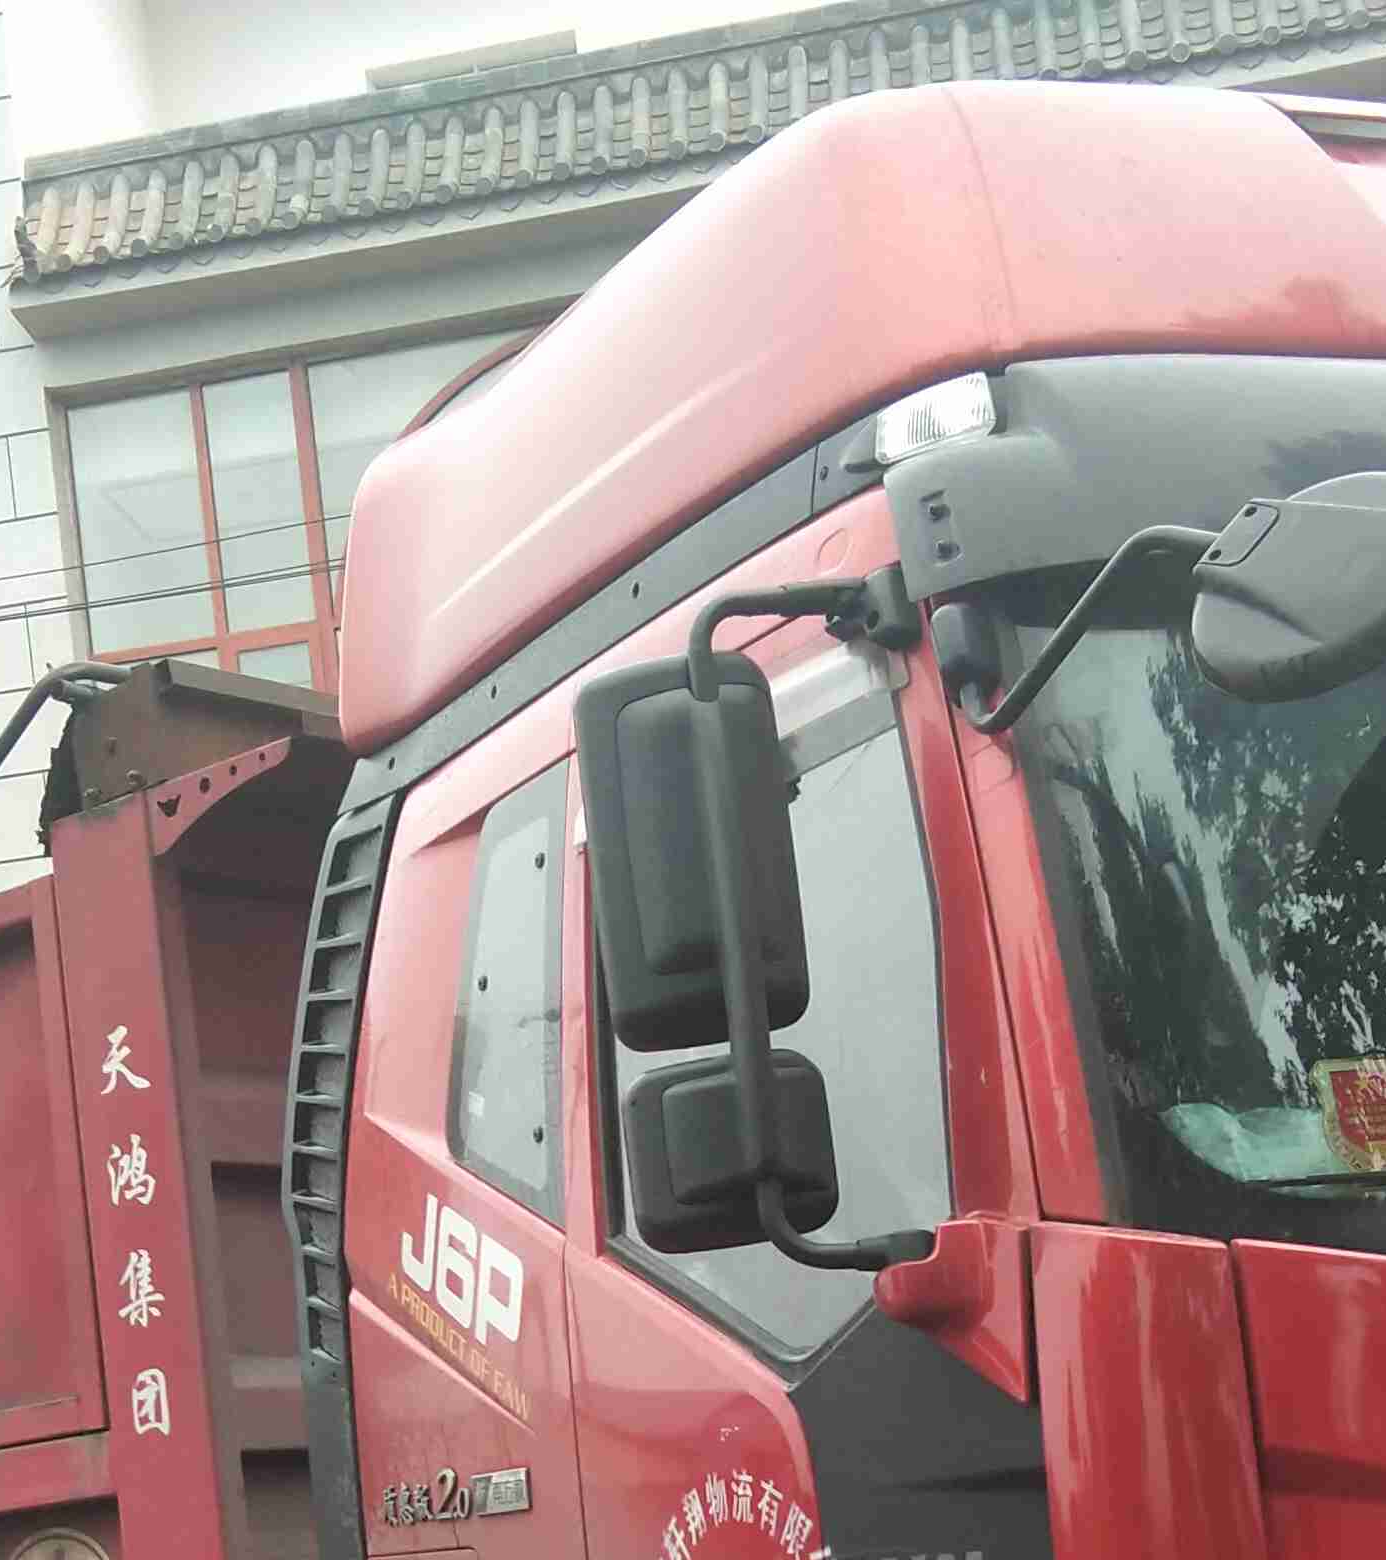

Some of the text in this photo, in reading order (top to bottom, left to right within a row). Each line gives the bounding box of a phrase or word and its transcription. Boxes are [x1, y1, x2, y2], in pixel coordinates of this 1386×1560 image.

[100, 1025, 171, 1437] 天鸿集团
[401, 1192, 523, 1345] J6P
[401, 1284, 468, 1362] PRODUCT
[470, 1349, 494, 1383] OF
[494, 1370, 532, 1420] FAW
